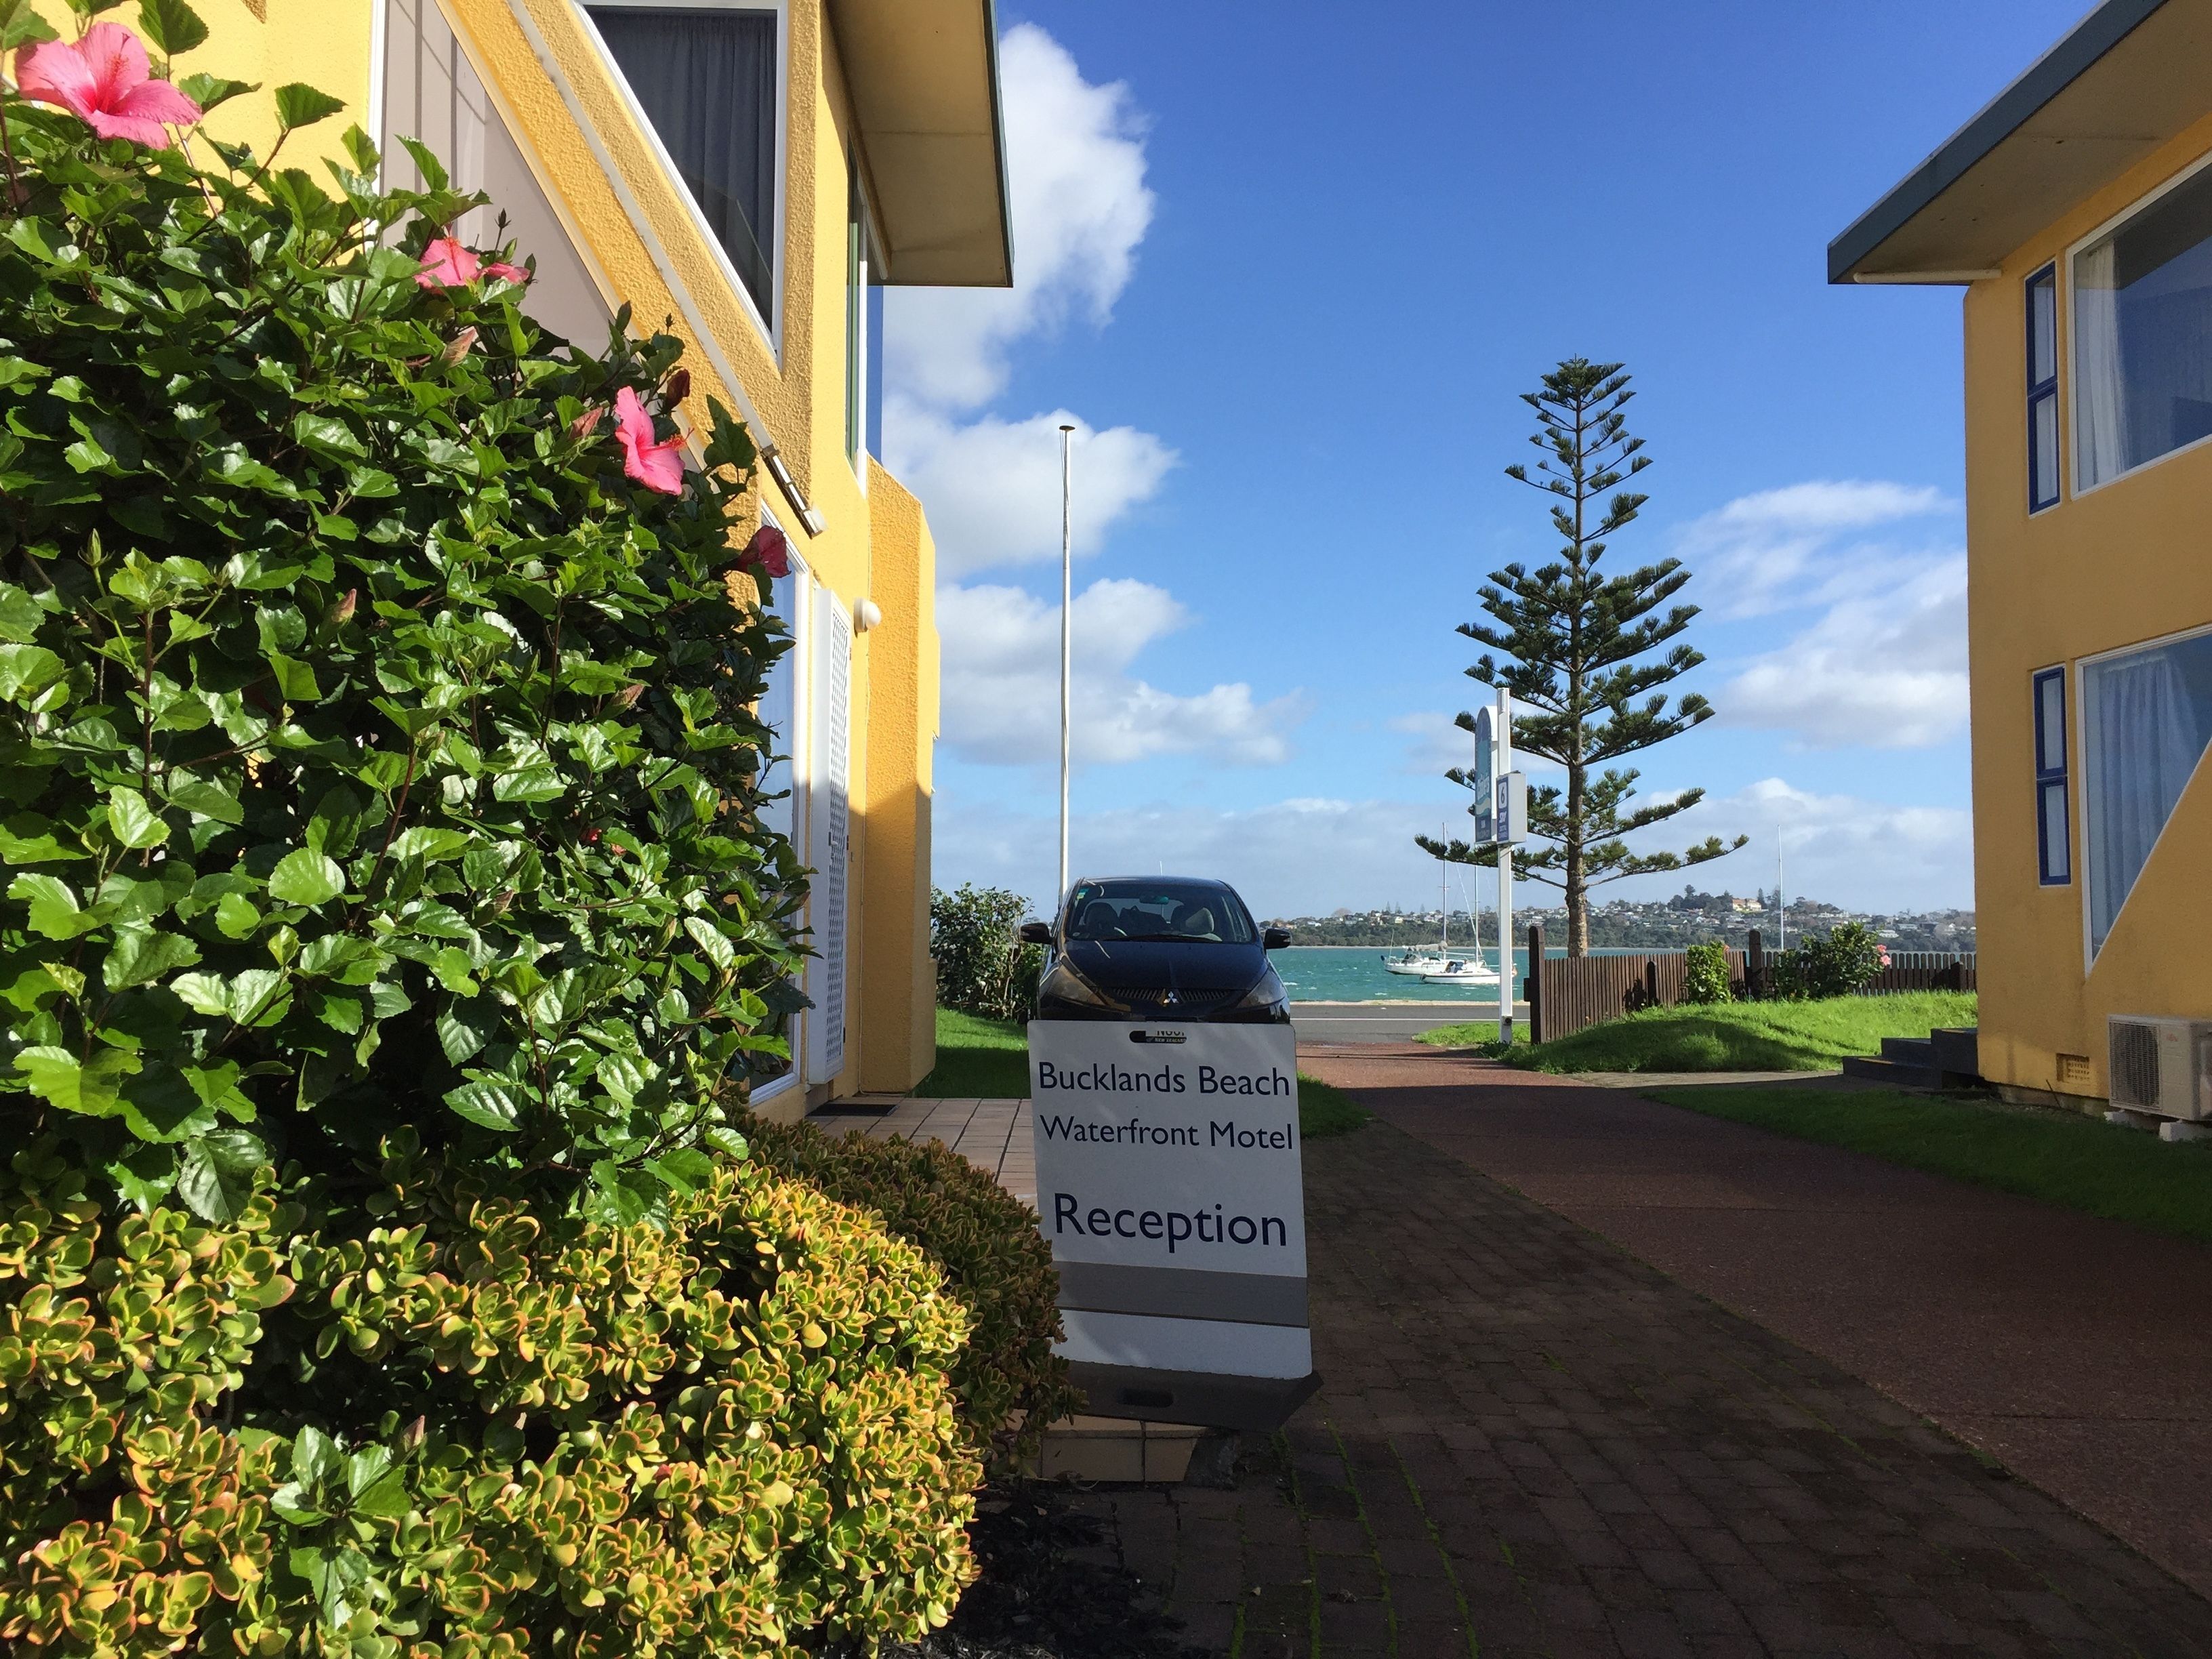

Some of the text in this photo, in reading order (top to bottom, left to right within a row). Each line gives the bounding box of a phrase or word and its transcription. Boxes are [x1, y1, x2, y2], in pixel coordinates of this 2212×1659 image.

[1500, 786, 1505, 804] 6
[1039, 1061, 1290, 1096] Bucklands Beach
[1039, 1114, 1292, 1149] Waterfront Motel
[1054, 1192, 1287, 1254] Reception
